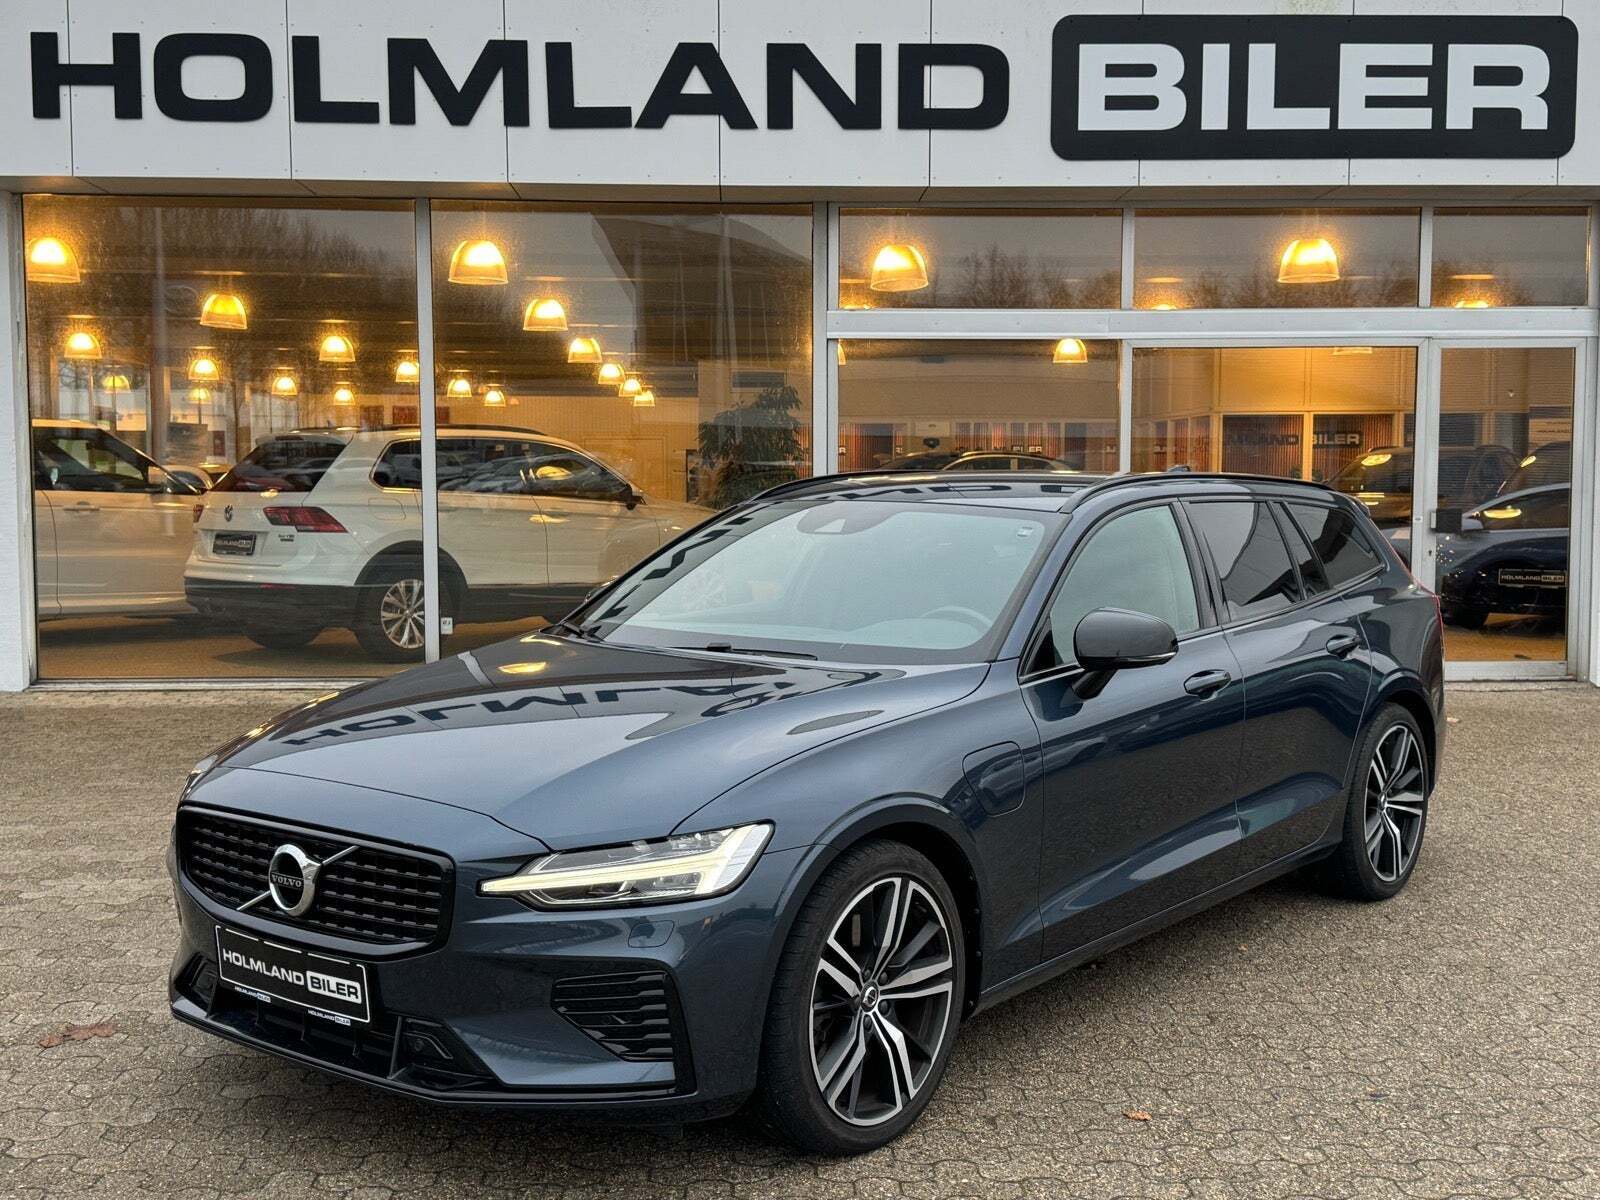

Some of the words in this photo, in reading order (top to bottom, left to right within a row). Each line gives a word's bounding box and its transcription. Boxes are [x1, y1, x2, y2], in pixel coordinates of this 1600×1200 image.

[29, 30, 1011, 132] HOLMLAND
[1077, 42, 1551, 132] BILER
[271, 874, 302, 888] VOLVO
[222, 947, 305, 987] HOLMLAND
[309, 975, 360, 1001] BILER
